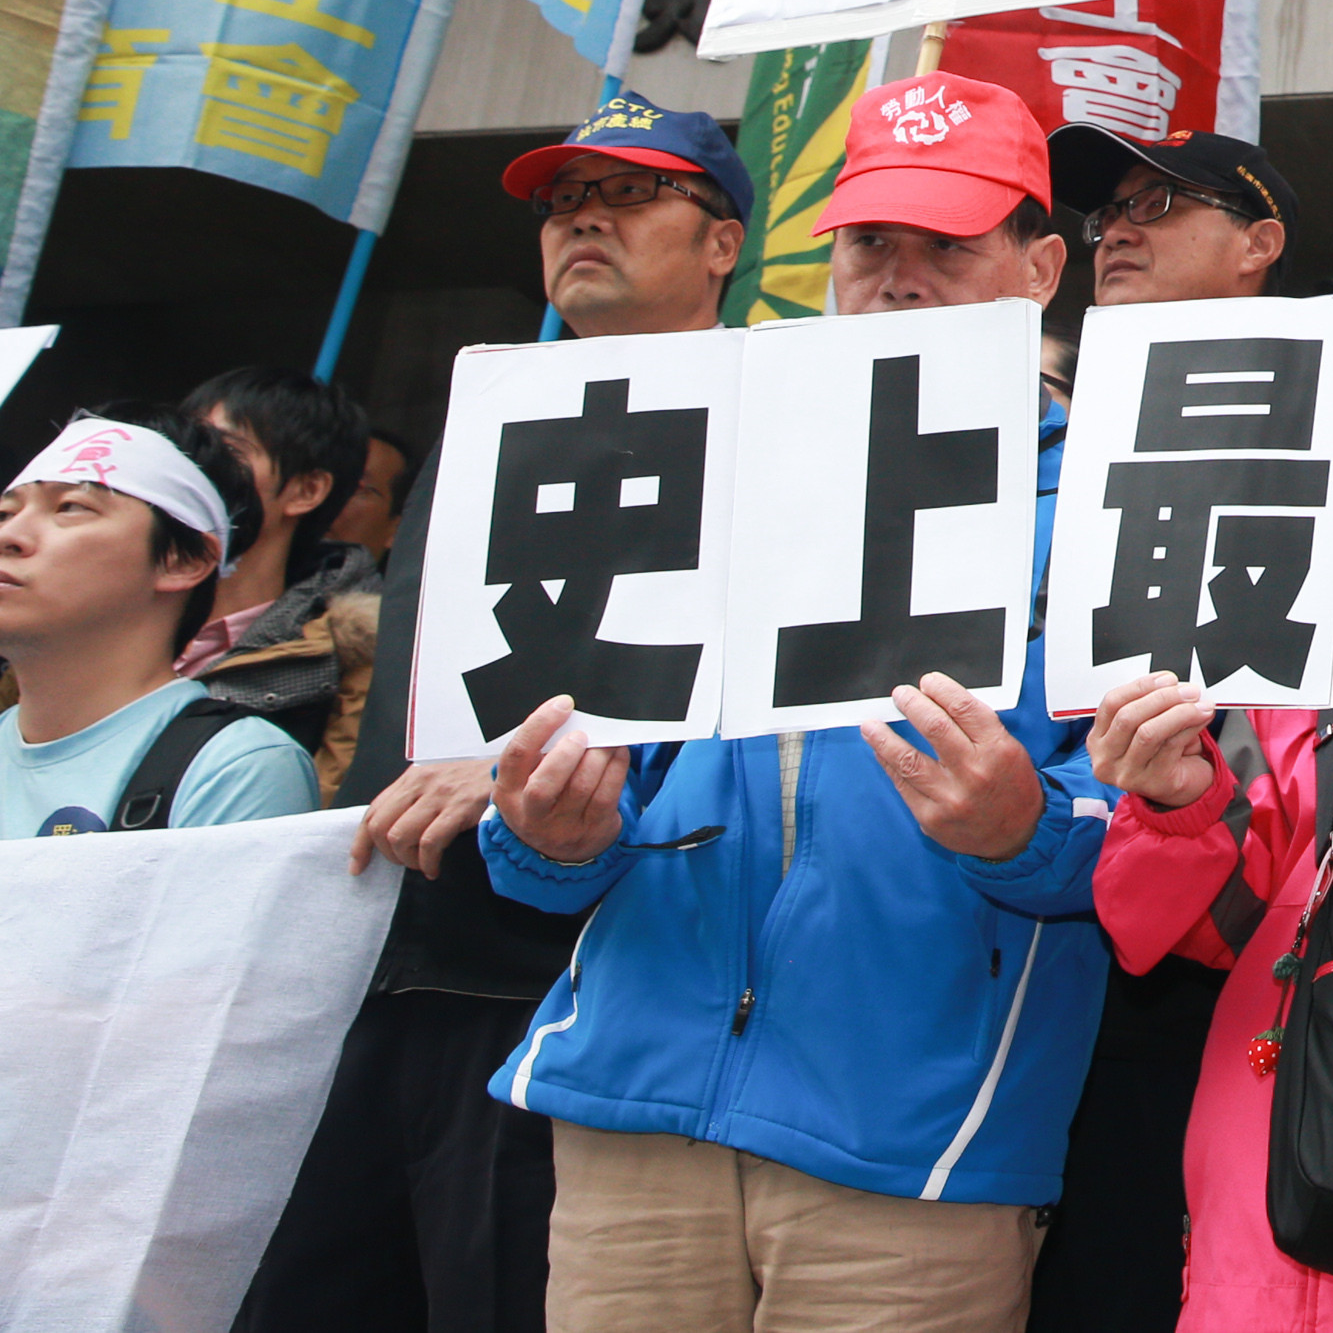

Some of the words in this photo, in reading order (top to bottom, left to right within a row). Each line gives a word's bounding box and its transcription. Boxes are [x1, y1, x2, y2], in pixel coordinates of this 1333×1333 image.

[461, 378, 709, 743] 史
[773, 355, 1006, 708] 上
[1092, 338, 1331, 690] 最
